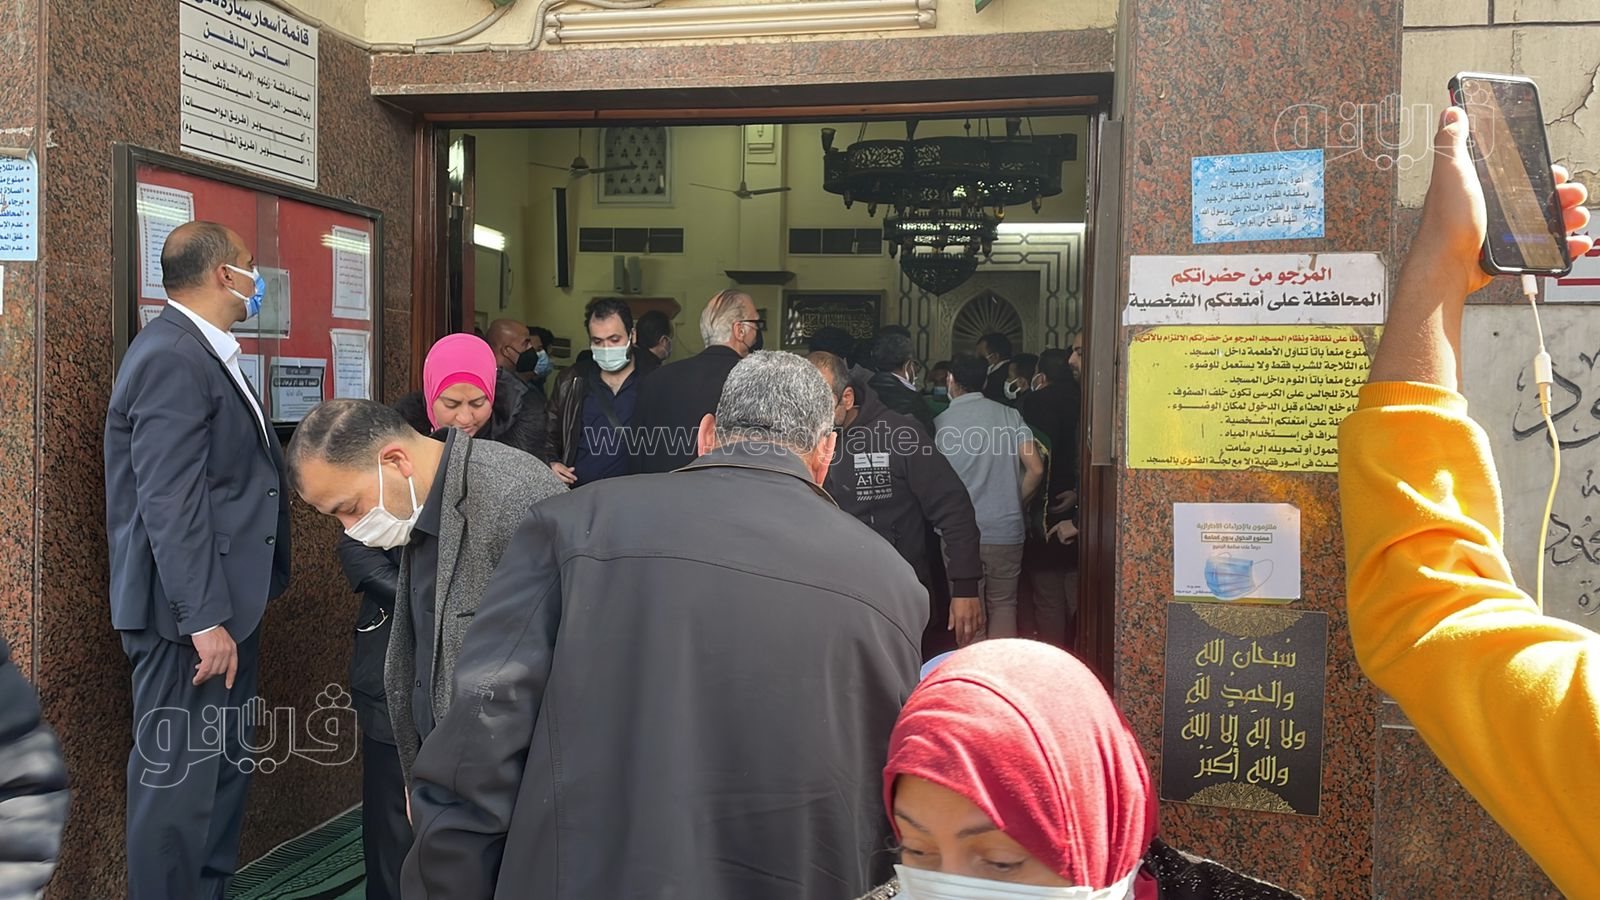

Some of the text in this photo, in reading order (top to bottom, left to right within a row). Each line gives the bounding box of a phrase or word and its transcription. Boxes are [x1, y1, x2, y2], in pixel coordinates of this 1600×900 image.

[281, 18, 309, 46] قائمة
[1171, 267, 1332, 286] المرجو من حضراتكم
[1129, 290, 1381, 311] المحافظة على أمتعتكم الشخصية
[1189, 334, 1220, 342] حضراتكم
[1222, 335, 1233, 344] من
[1234, 335, 1258, 344] المرجو
[1259, 335, 1287, 344] المسجد
[1190, 348, 1219, 357] المسجد
[1224, 347, 1246, 357] داخل
[1345, 347, 1368, 358] منوع
[1190, 361, 1219, 371] للوضوء
[1257, 361, 1270, 371] ولا
[1271, 361, 1291, 370] فقط
[1292, 361, 1322, 372] للشرب
[1324, 361, 1357, 371] الثلاجة
[1229, 376, 1262, 386] المسجد
[1263, 375, 1285, 386] داخل
[1286, 376, 1308, 386] النوم
[1344, 376, 1367, 387] منوع
[1173, 387, 1207, 398] الصفوف
[1208, 388, 1228, 397] خلف
[1229, 388, 1251, 399] تكون
[1286, 390, 1305, 400] على
[1306, 390, 1338, 400] للجالس
[1223, 401, 1246, 412] لمكان
[1281, 403, 1298, 413] قبل
[1328, 403, 1345, 415] خلع
[1309, 419, 1327, 428] على
[1304, 444, 1312, 455] أو
